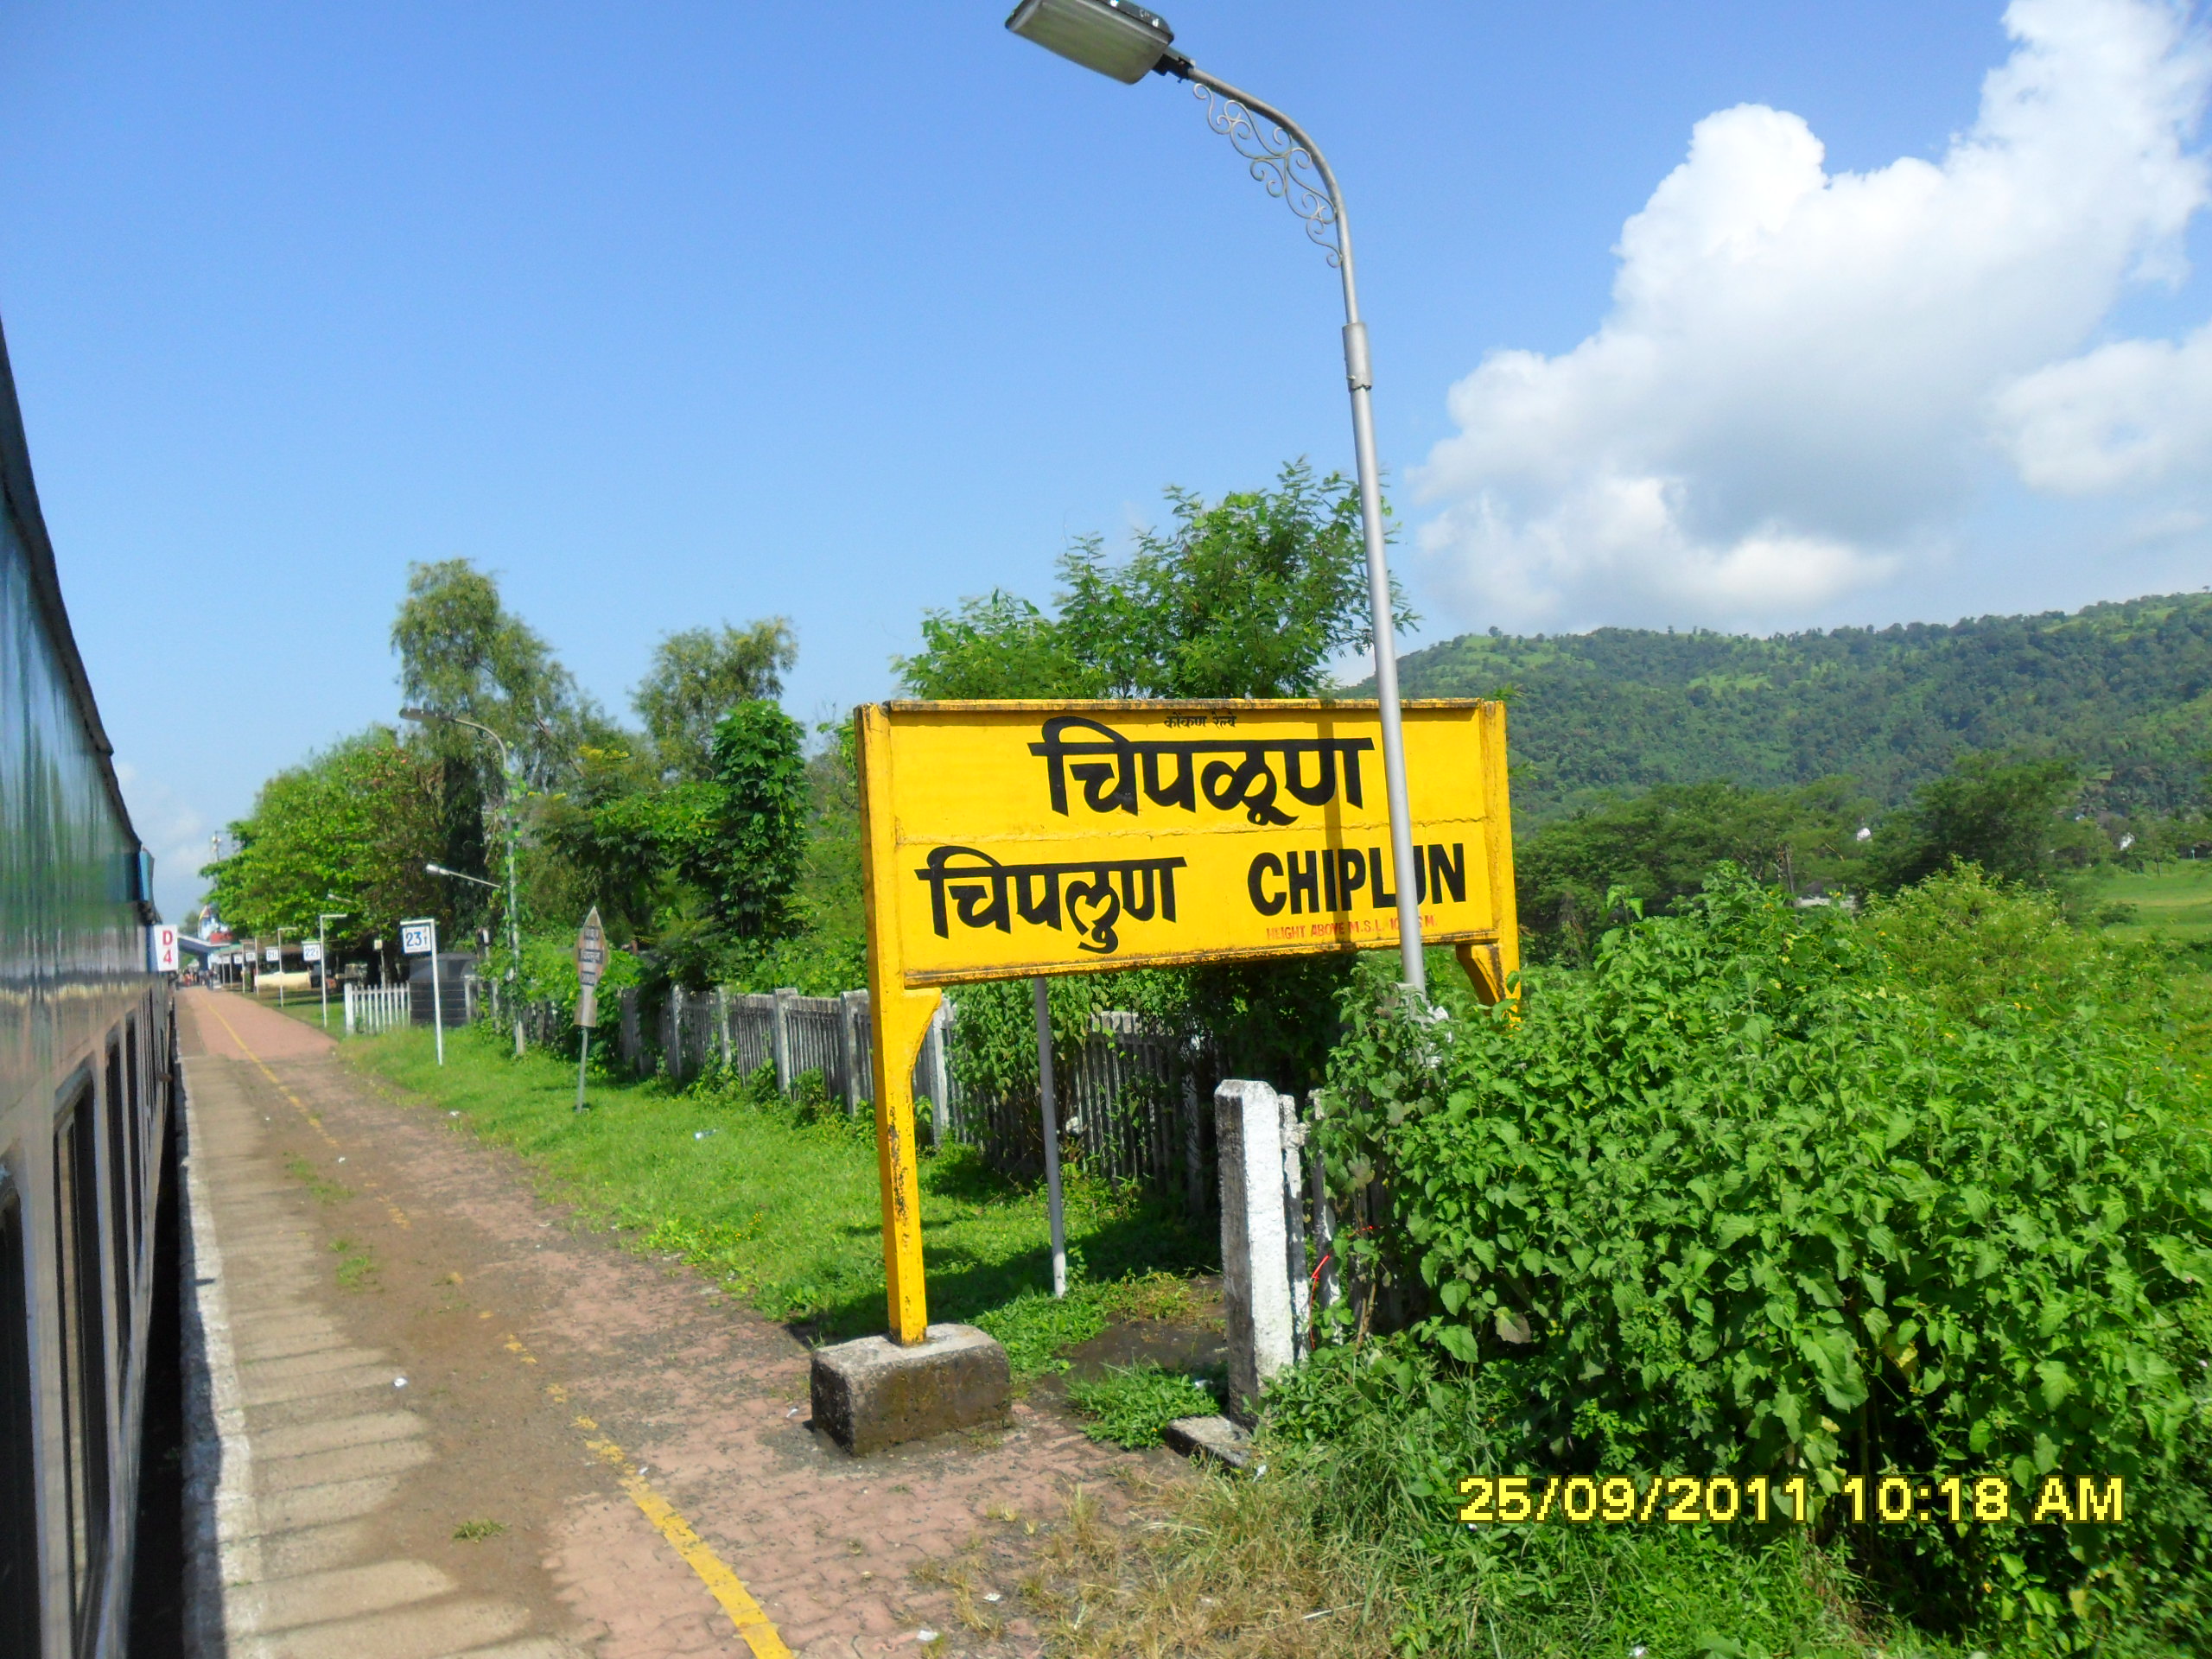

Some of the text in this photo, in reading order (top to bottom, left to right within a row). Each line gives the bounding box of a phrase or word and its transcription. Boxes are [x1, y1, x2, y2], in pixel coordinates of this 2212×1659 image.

[1027, 715, 1376, 826] चिपळूण
[914, 845, 1188, 954] चिपलुण
[162, 930, 174, 945] D
[405, 931, 423, 947] 23
[1266, 925, 1306, 940] HEIGHT
[1310, 922, 1345, 937] ABOVE
[162, 950, 173, 963] 4
